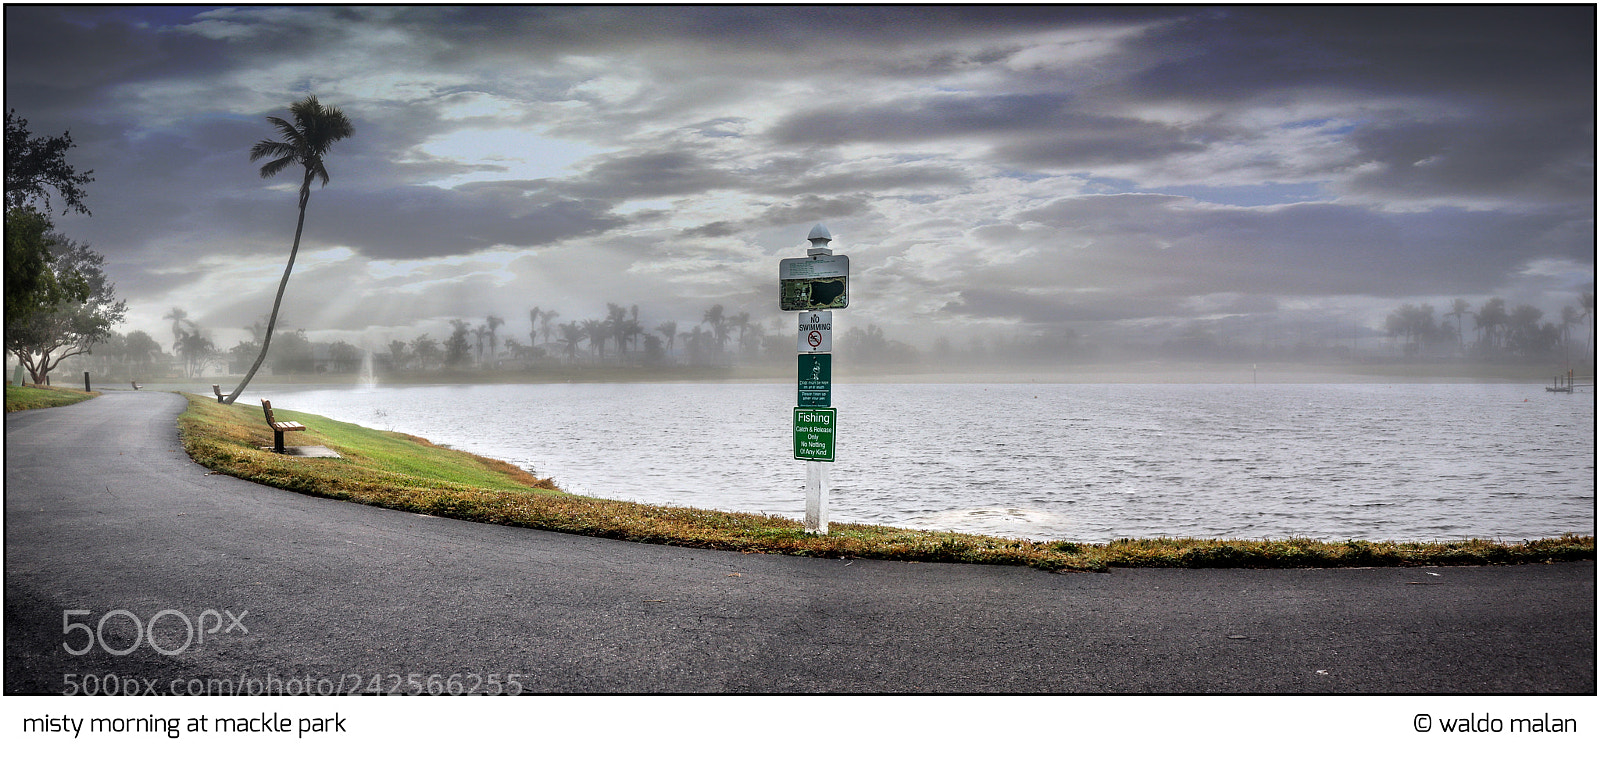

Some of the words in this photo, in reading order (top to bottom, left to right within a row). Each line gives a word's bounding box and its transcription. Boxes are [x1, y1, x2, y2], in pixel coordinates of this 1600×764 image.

[799, 323, 831, 331] SWIMMING
[798, 412, 830, 425] Fishing
[807, 433, 819, 441] Only
[808, 441, 825, 449] Netting
[806, 448, 815, 456] Any
